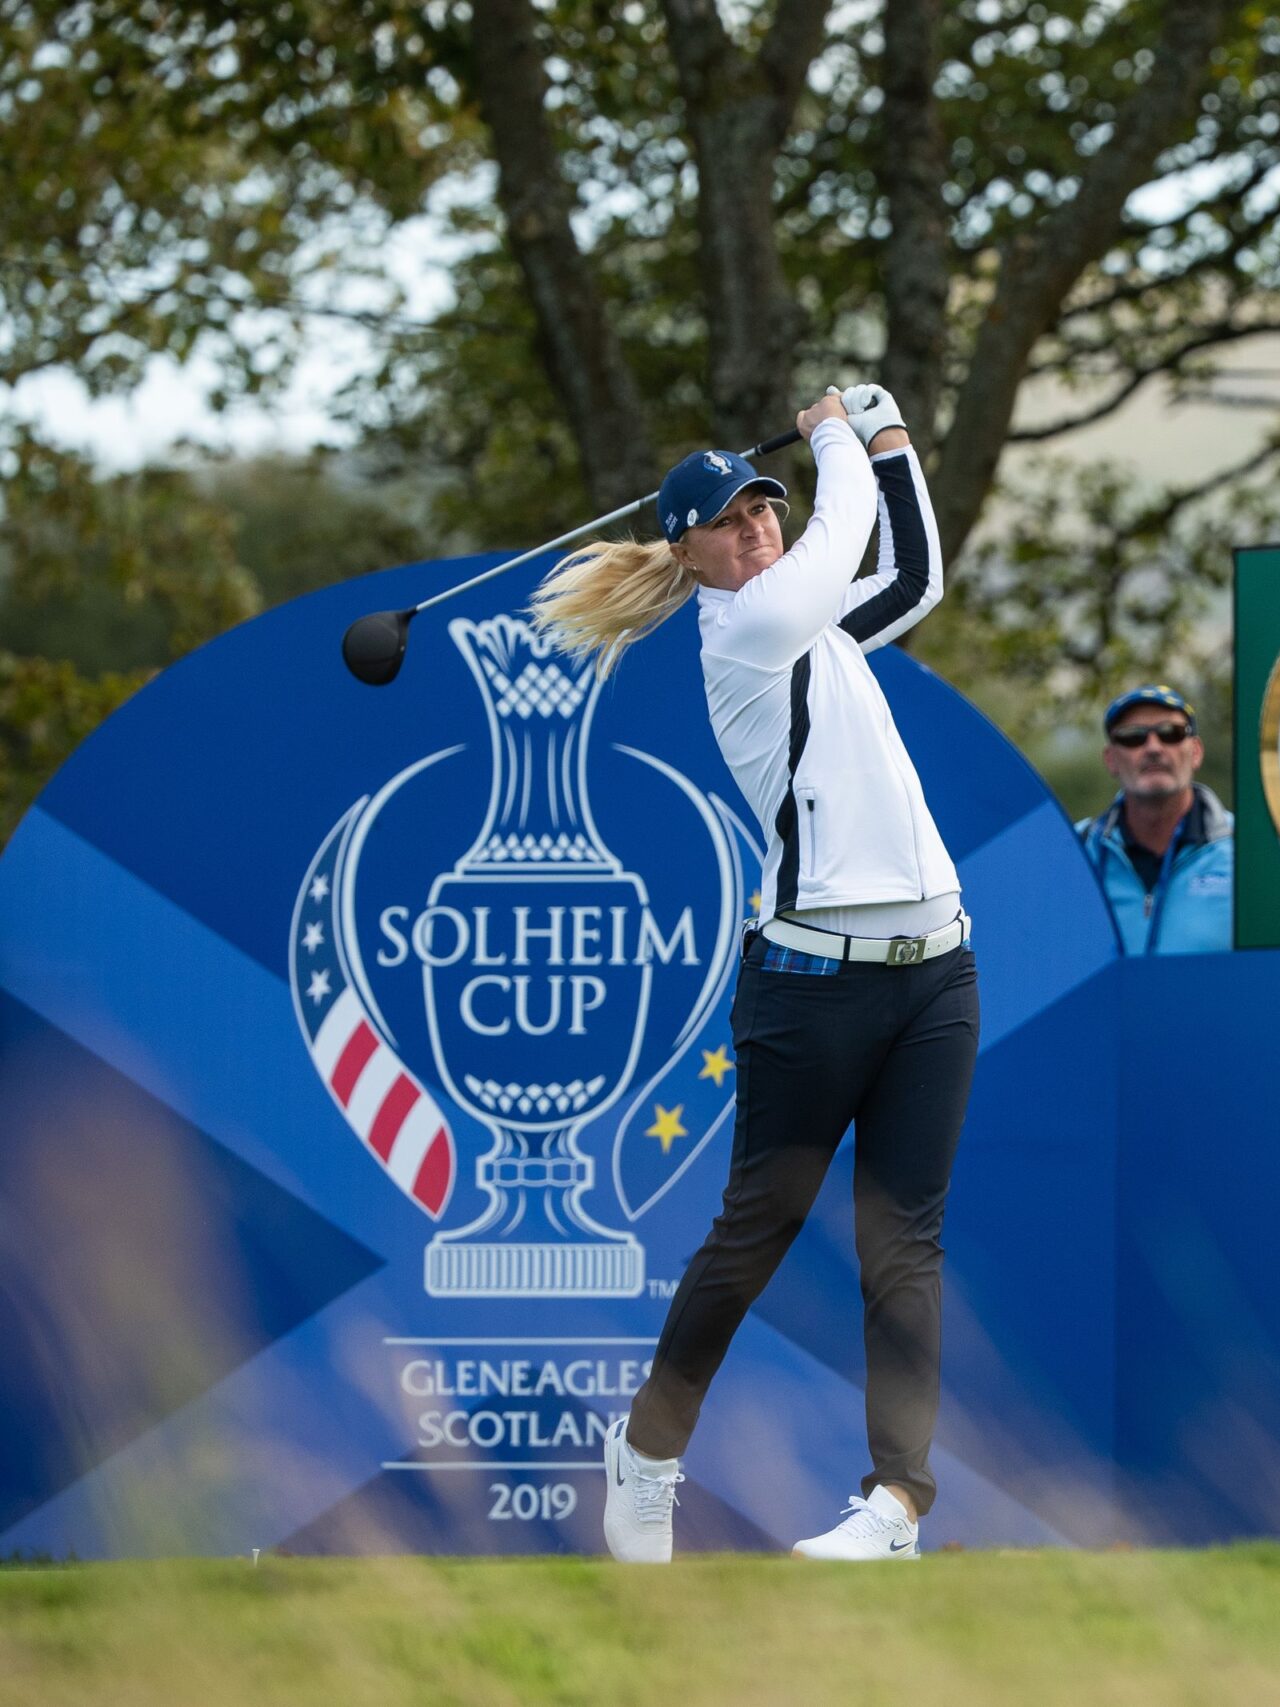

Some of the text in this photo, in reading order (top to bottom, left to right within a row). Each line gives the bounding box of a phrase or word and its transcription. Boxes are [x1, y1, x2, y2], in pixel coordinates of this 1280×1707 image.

[376, 904, 701, 968] SOLHEIM
[459, 974, 607, 1036] CUP
[418, 1410, 629, 1448] SCOTLAN
[487, 1483, 578, 1520] 2019
